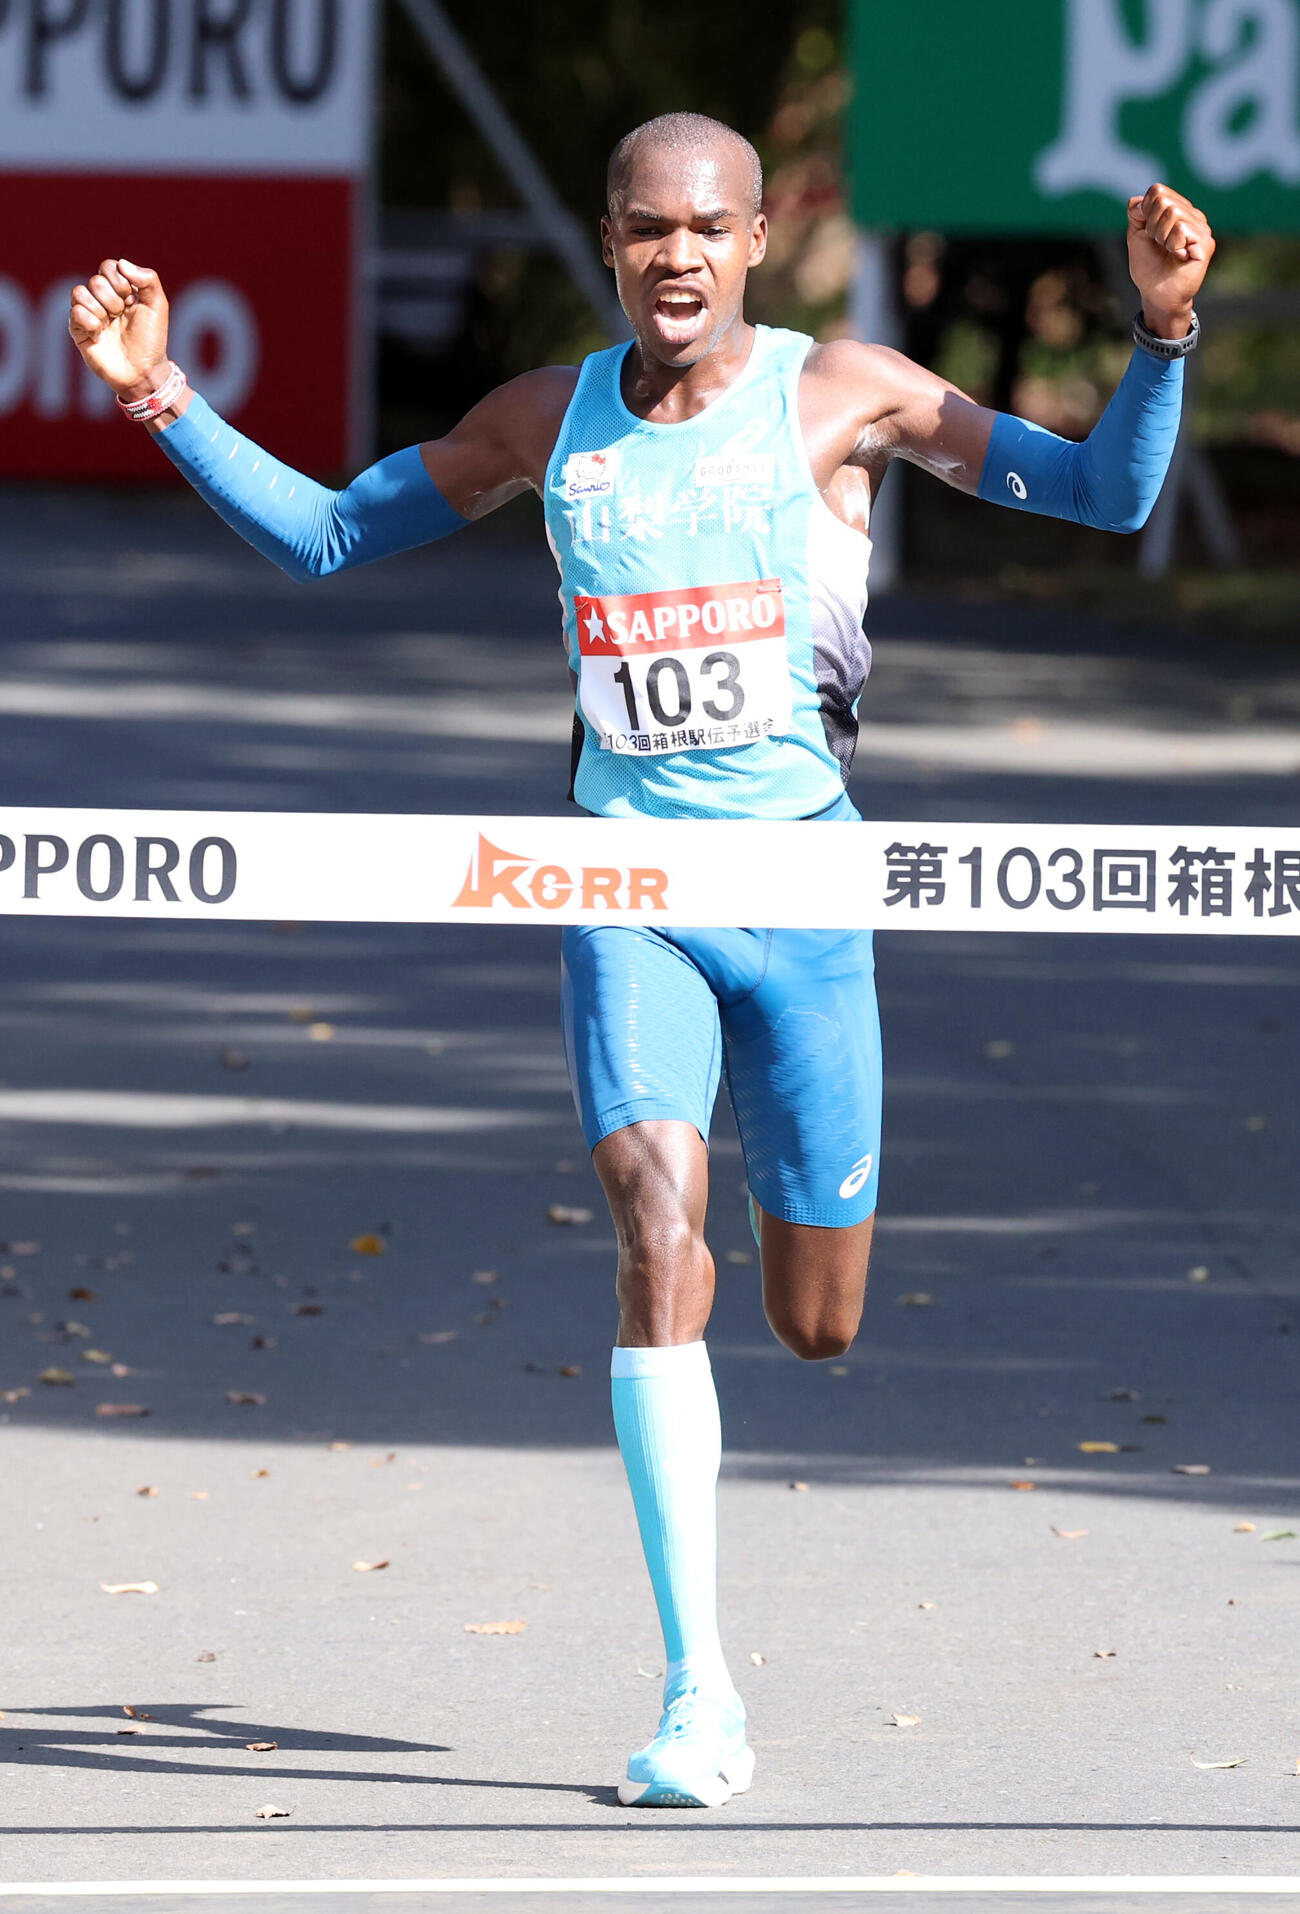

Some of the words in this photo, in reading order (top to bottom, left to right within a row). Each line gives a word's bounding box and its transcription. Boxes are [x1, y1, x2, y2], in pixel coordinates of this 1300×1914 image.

[0, 0, 338, 107] PORO
[606, 594, 777, 645] SAPPORO
[613, 651, 746, 731] 103
[602, 717, 775, 752] 103回箱根駅伝予選会
[882, 841, 1300, 918] 第103回箱根
